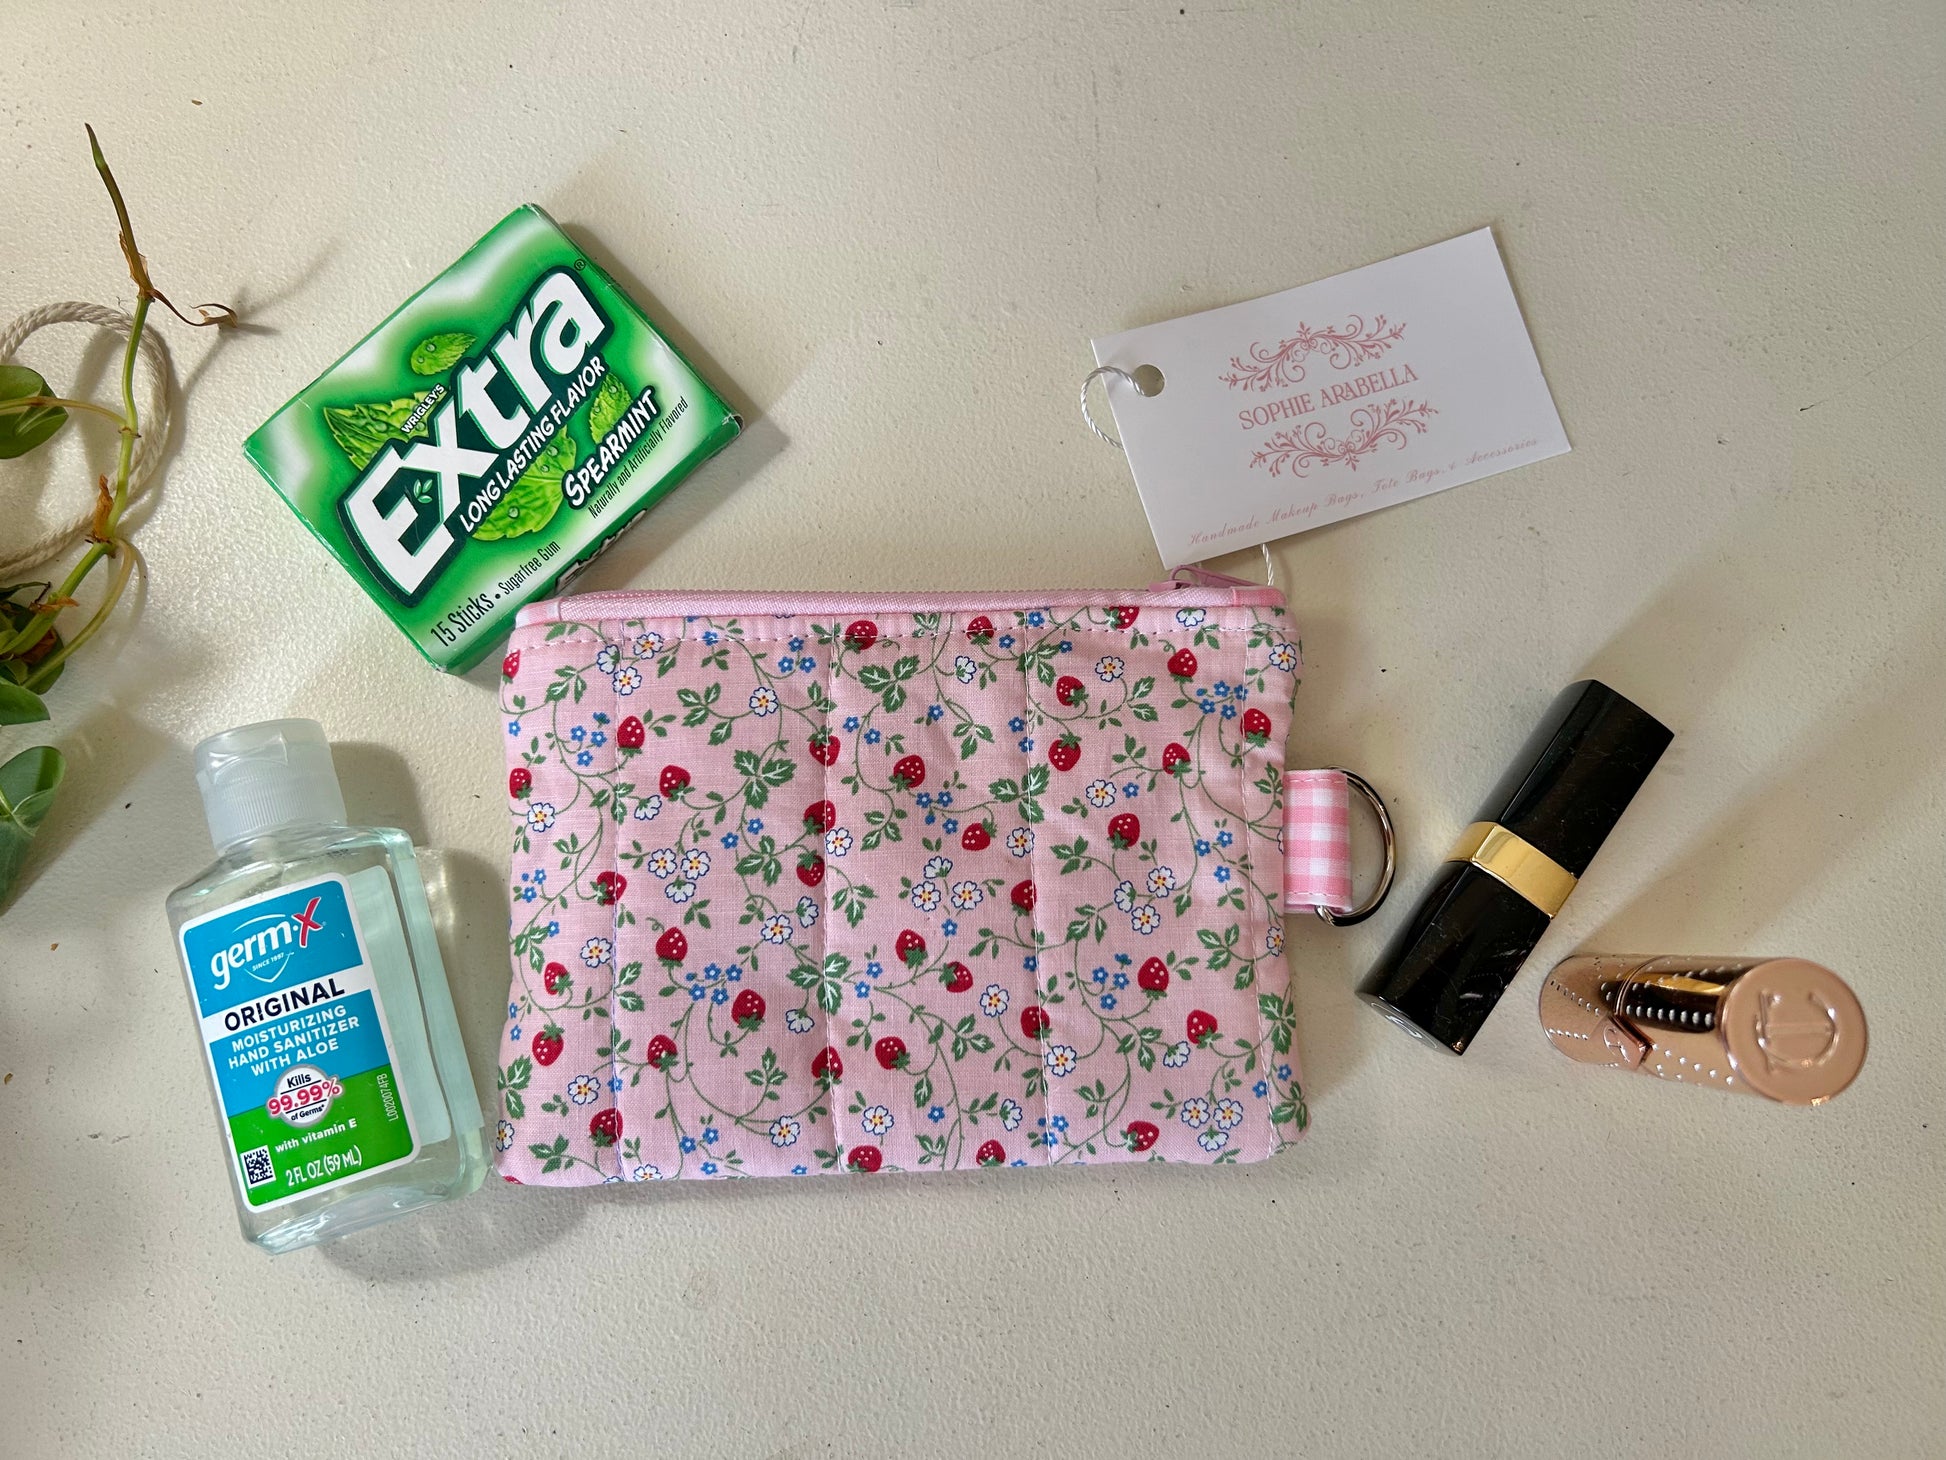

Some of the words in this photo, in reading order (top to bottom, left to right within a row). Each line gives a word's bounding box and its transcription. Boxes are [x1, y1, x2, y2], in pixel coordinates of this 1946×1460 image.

[401, 384, 446, 434] WRIGLEY'S
[1238, 393, 1316, 431] SOPHIE
[1320, 363, 1419, 408] ARABELLA
[344, 272, 606, 596] Extra
[460, 478, 501, 533] LONG
[496, 415, 555, 489] LASTING
[551, 355, 606, 425] FLAVOR
[565, 389, 658, 507] SPEARMINT
[588, 481, 621, 519] Naturally
[617, 464, 632, 486] and
[630, 431, 664, 475] Artificially
[659, 396, 689, 434] Flavored
[1187, 515, 1260, 546] Handmade
[1265, 502, 1319, 525] Makeup
[1465, 438, 1538, 466] Accessories
[430, 620, 457, 647] 15
[448, 592, 495, 635] Sticks
[498, 554, 543, 596] Sugarfree
[540, 539, 562, 564] Gum
[224, 978, 345, 1032] ORIGINAL
[231, 1004, 347, 1053] MOISTURIZING
[228, 1046, 270, 1070] HAND
[274, 1016, 360, 1054] SANITIZER
[250, 1054, 291, 1077] WITH
[296, 1038, 339, 1063] ALOE
[268, 1079, 341, 1115] 99.99%
[287, 1073, 312, 1089] Kills
[275, 1139, 300, 1153] with
[302, 1123, 346, 1144] vitamin
[348, 1118, 358, 1128] E
[291, 1113, 299, 1121] of
[307, 1159, 325, 1180] OZ
[323, 1152, 342, 1176] (59
[343, 1145, 363, 1167] ML)
